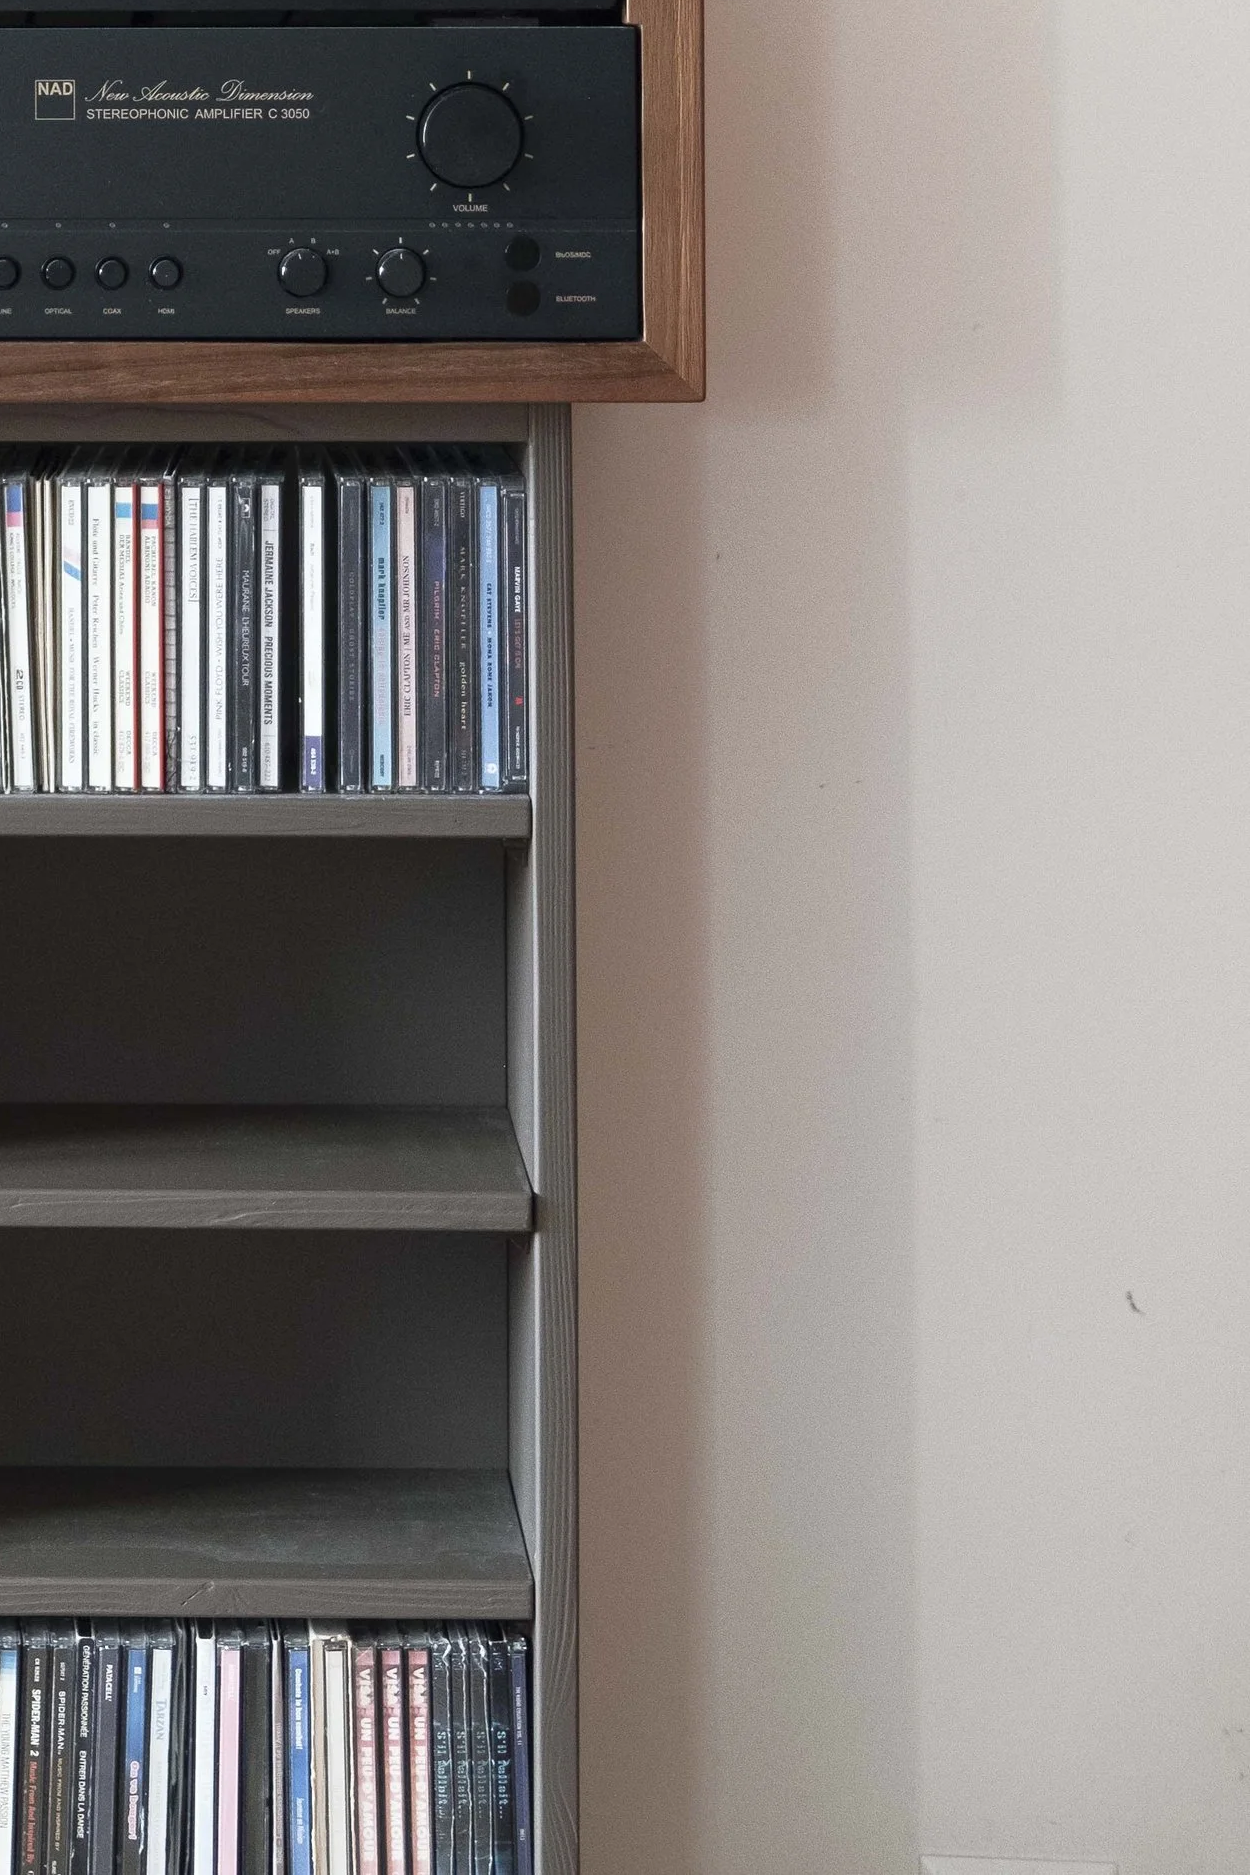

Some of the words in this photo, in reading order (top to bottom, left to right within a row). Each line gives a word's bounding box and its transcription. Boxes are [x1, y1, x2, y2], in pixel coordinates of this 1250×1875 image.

[38, 82, 73, 96] NAD
[85, 79, 129, 102] New
[133, 79, 209, 102] Acoustic
[216, 79, 314, 102] Dimension
[86, 108, 189, 120] STEREOPHONIC
[194, 108, 263, 120] AMPLIFIER
[268, 108, 278, 120] C
[281, 108, 310, 120] 3050
[452, 203, 488, 213] VOLUME
[286, 307, 321, 315] SPEAKERS
[386, 307, 416, 315] BALANCE
[215, 557, 223, 580] HERE
[264, 540, 274, 584] JERMAINE
[402, 556, 410, 598] JOHNSON
[215, 583, 223, 610] WERE
[241, 569, 250, 612] MAURANE
[264, 587, 274, 628] JACKSON
[402, 599, 411, 613] MR
[215, 611, 223, 630] YOU
[215, 633, 223, 656] WISH
[241, 616, 250, 660] L'HEUREUX
[402, 632, 411, 646] ME
[264, 636, 273, 678] PRECIOUS
[215, 666, 223, 695] FLOYD
[241, 663, 250, 686] TOUR
[403, 654, 411, 694] CLAPTON
[459, 662, 467, 697] golden
[215, 700, 223, 720] PINK
[264, 680, 273, 725] MOMENTS
[403, 697, 411, 717] ERIC
[81, 1645, 91, 1691] GÉNÉRATION
[2, 1712, 12, 1727] THE
[30, 1689, 41, 1745] SPIDER-MAN
[80, 1692, 90, 1738] PASSIONNÉE
[155, 1699, 167, 1740] TARZAN
[361, 1717, 370, 1740] UN
[387, 1717, 397, 1740] UN
[414, 1717, 424, 1740] UN
[1, 1729, 11, 1756] YOUNG
[29, 1760, 39, 1784] Music
[78, 1750, 86, 1780] ENTRER
[130, 1760, 139, 1777] On
[361, 1746, 372, 1775] PEU
[388, 1746, 399, 1775] PEU
[415, 1746, 425, 1775] PEU
[0, 1757, 10, 1795] MATTHEW
[129, 1778, 138, 1794] va
[28, 1785, 37, 1805] From
[77, 1781, 85, 1802] DANS
[0, 1797, 9, 1829] PASSION
[28, 1806, 37, 1821] And
[77, 1803, 85, 1812] LA
[127, 1795, 139, 1840] bouger!
[76, 1813, 85, 1839] DANSE
[362, 1782, 374, 1861] D'AMOUR
[390, 1782, 401, 1861] D'AMOUR
[416, 1782, 428, 1861] D'AMOUR
[26, 1822, 36, 1852] Inspired
[25, 1853, 35, 1864] By
